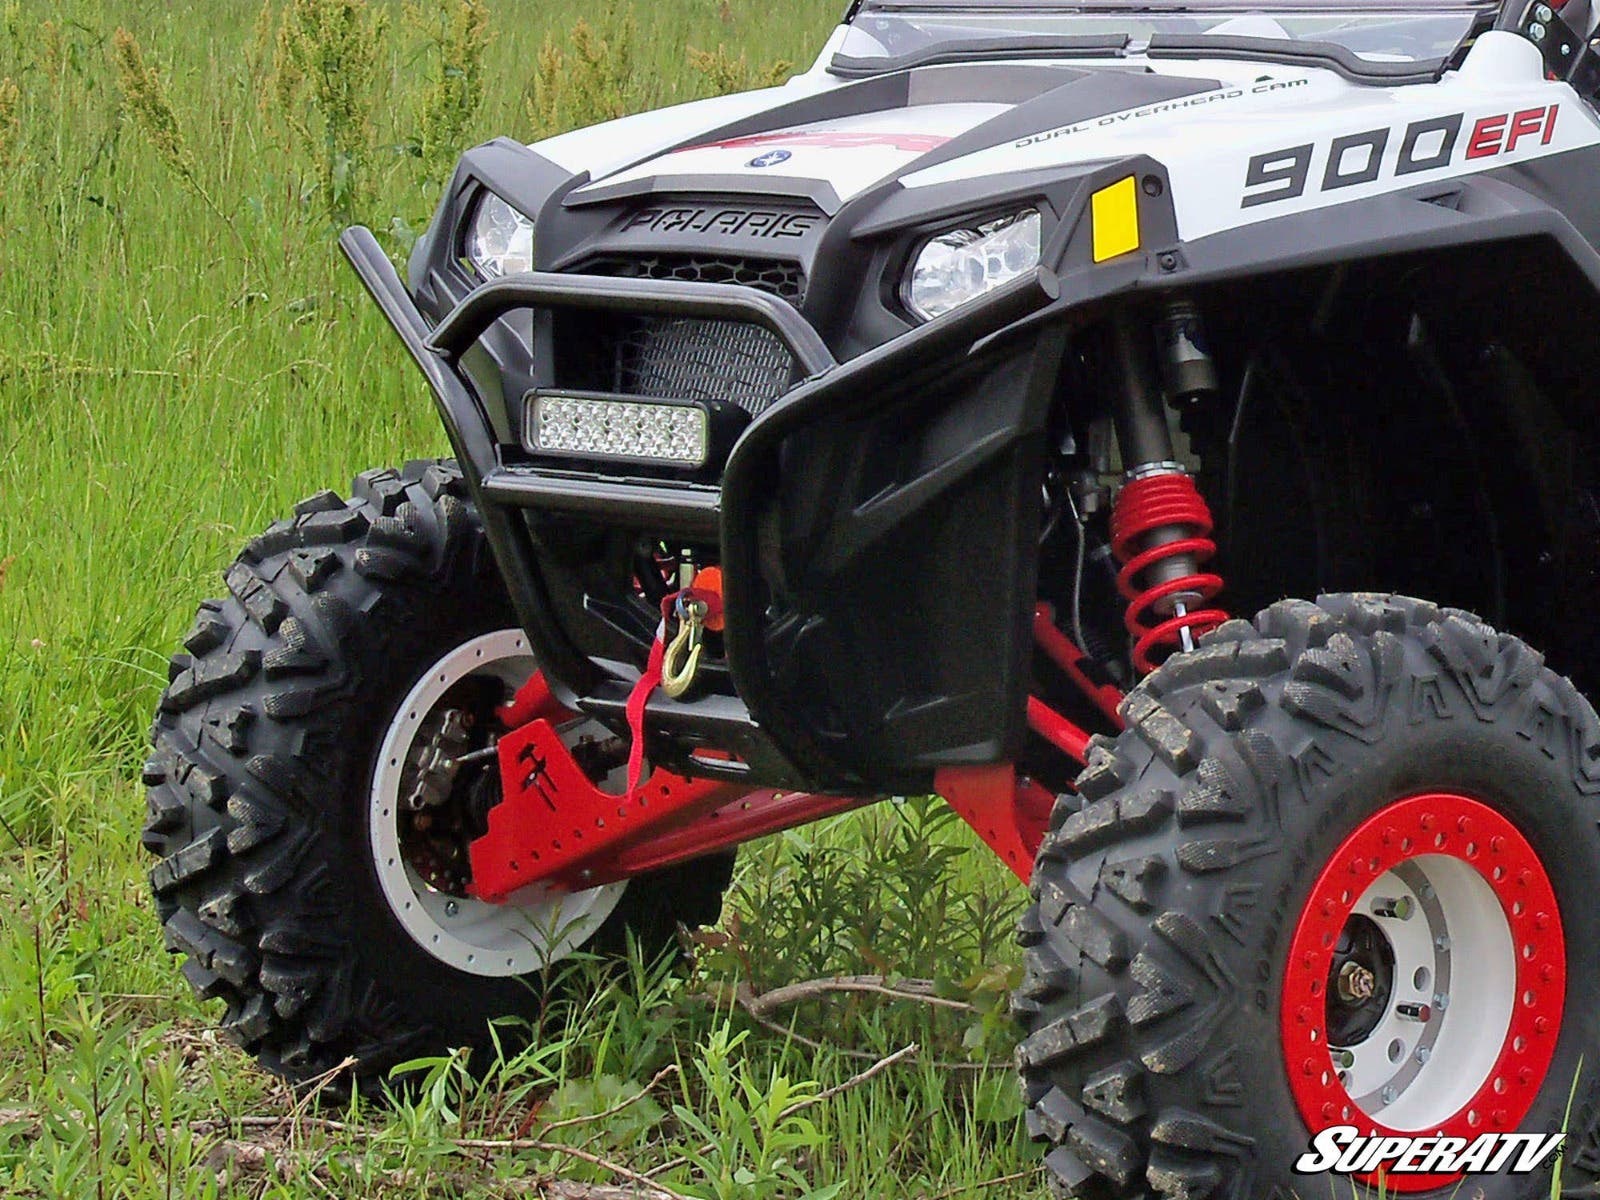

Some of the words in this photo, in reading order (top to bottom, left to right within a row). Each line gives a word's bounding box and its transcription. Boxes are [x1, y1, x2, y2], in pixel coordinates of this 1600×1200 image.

[1014, 125, 1090, 149] DUAL
[1097, 89, 1244, 127] OVERHEAD
[1251, 78, 1309, 94] CAM
[619, 208, 821, 238] POLARIS
